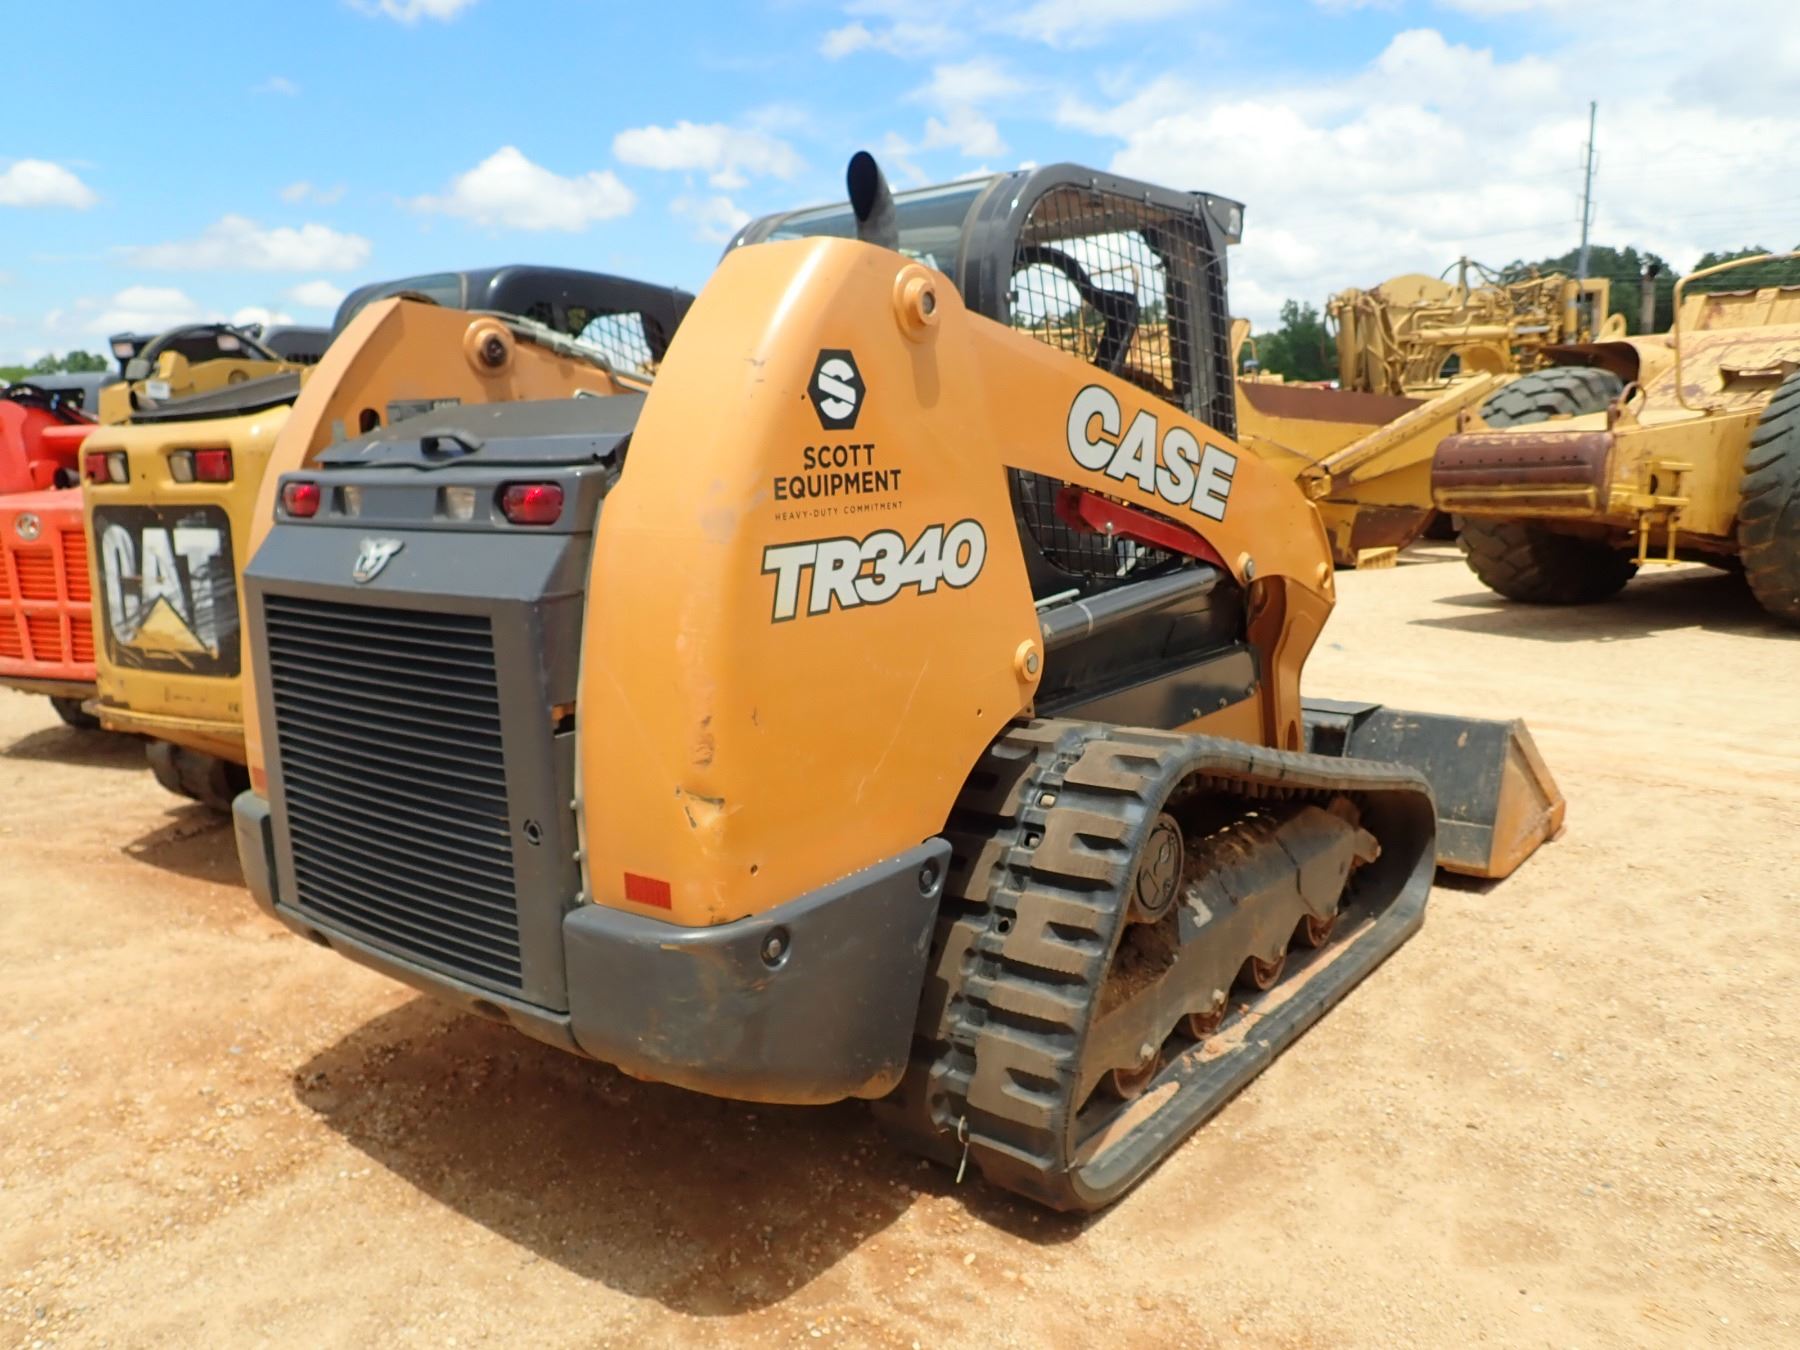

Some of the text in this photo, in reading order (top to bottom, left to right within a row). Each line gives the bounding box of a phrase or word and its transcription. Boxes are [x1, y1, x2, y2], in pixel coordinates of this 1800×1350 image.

[773, 469, 902, 501] EQUIPMENT
[803, 444, 875, 470] SCOTT
[1066, 384, 1238, 522] CASE
[774, 501, 903, 521] HEAVY-DUTY COMMITMENT
[102, 524, 221, 656] CAT
[760, 518, 988, 624] TR340
